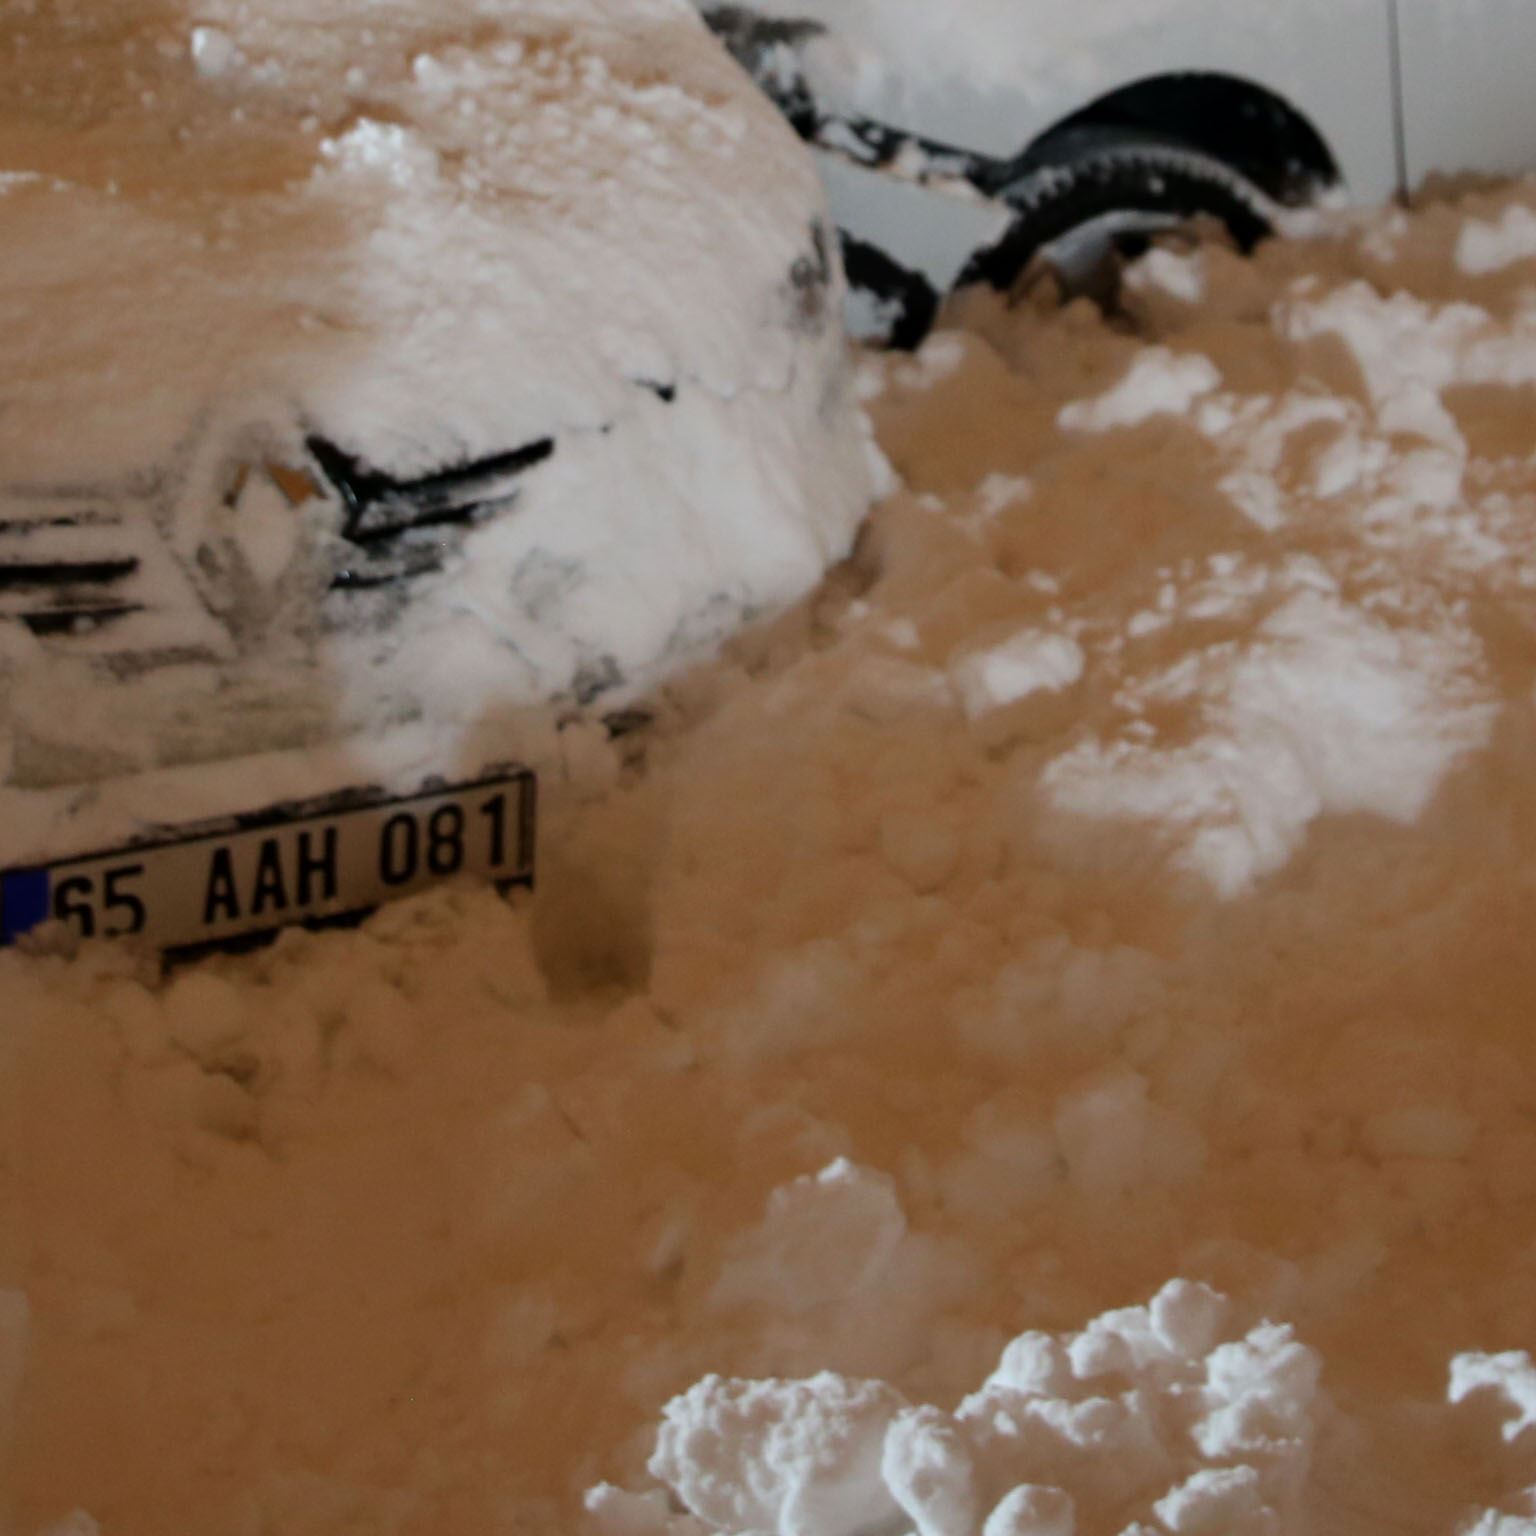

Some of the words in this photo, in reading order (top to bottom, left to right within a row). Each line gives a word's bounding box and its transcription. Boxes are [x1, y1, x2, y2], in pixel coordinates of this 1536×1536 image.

[53, 864, 146, 937] 65
[203, 826, 339, 924] AAH
[378, 793, 507, 886] 081
